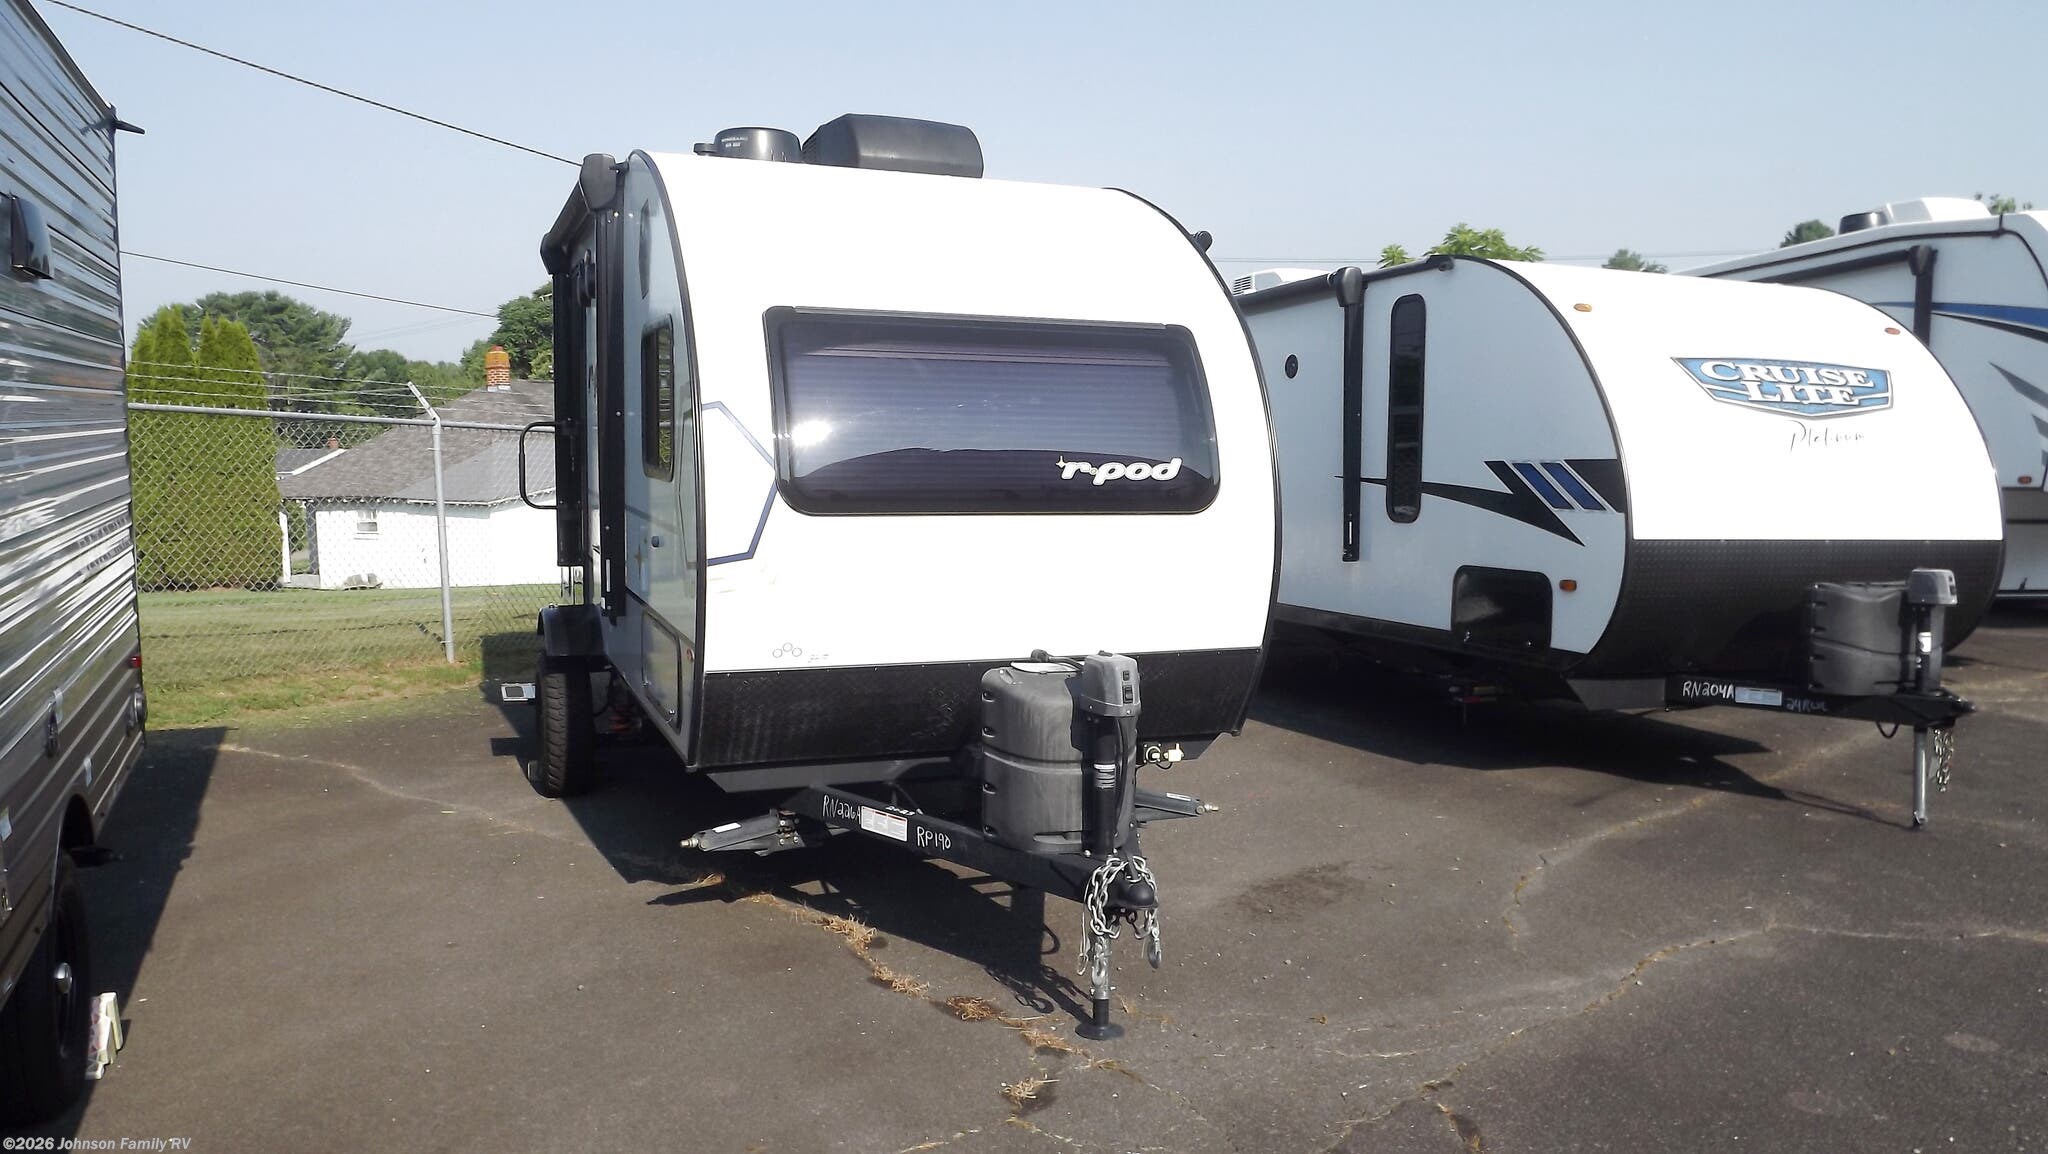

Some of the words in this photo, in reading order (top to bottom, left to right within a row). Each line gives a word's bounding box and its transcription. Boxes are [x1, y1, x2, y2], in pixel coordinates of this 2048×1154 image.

[1700, 361, 1875, 387] CRUISE
[1741, 381, 1860, 405] LITE
[1682, 680, 1735, 699] RN204A
[916, 826, 952, 850] RP190
